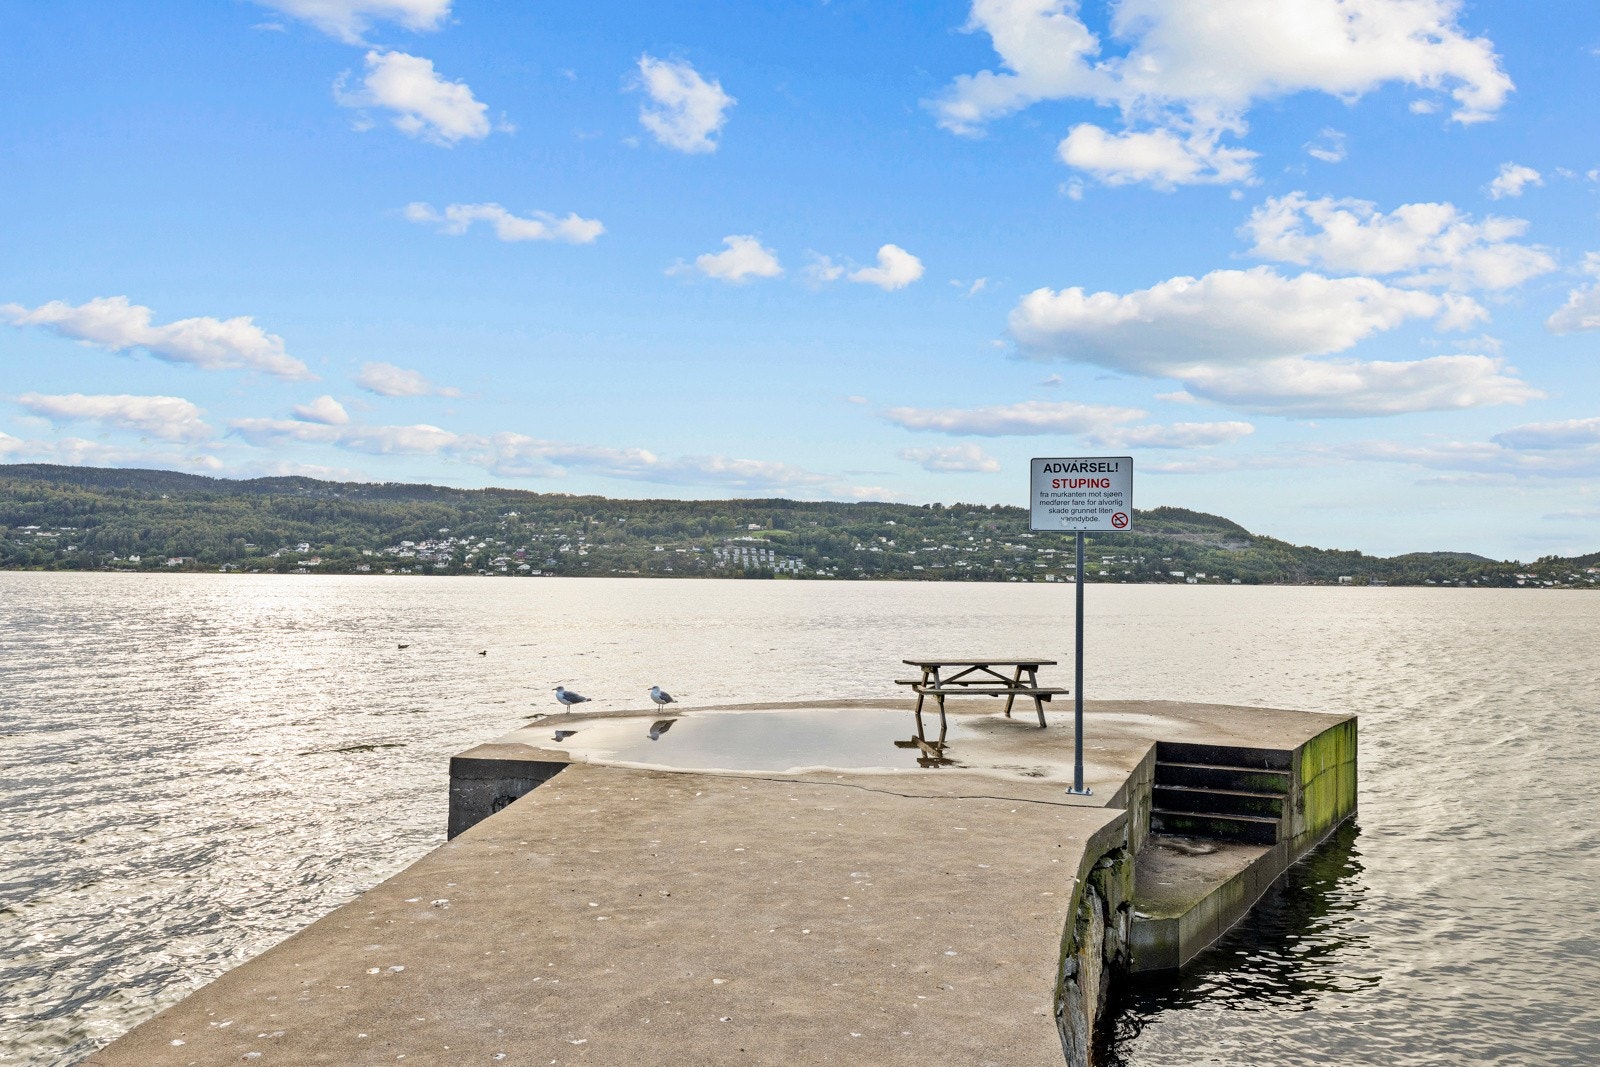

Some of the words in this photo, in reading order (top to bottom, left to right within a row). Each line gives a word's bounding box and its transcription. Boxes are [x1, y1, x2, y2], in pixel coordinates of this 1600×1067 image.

[1043, 462, 1118, 473] ADVARSEL!
[1052, 478, 1110, 488] STUPING
[1103, 491, 1122, 499] sjøen
[1098, 499, 1123, 507] alvorlig
[1071, 507, 1097, 515] grunnet
